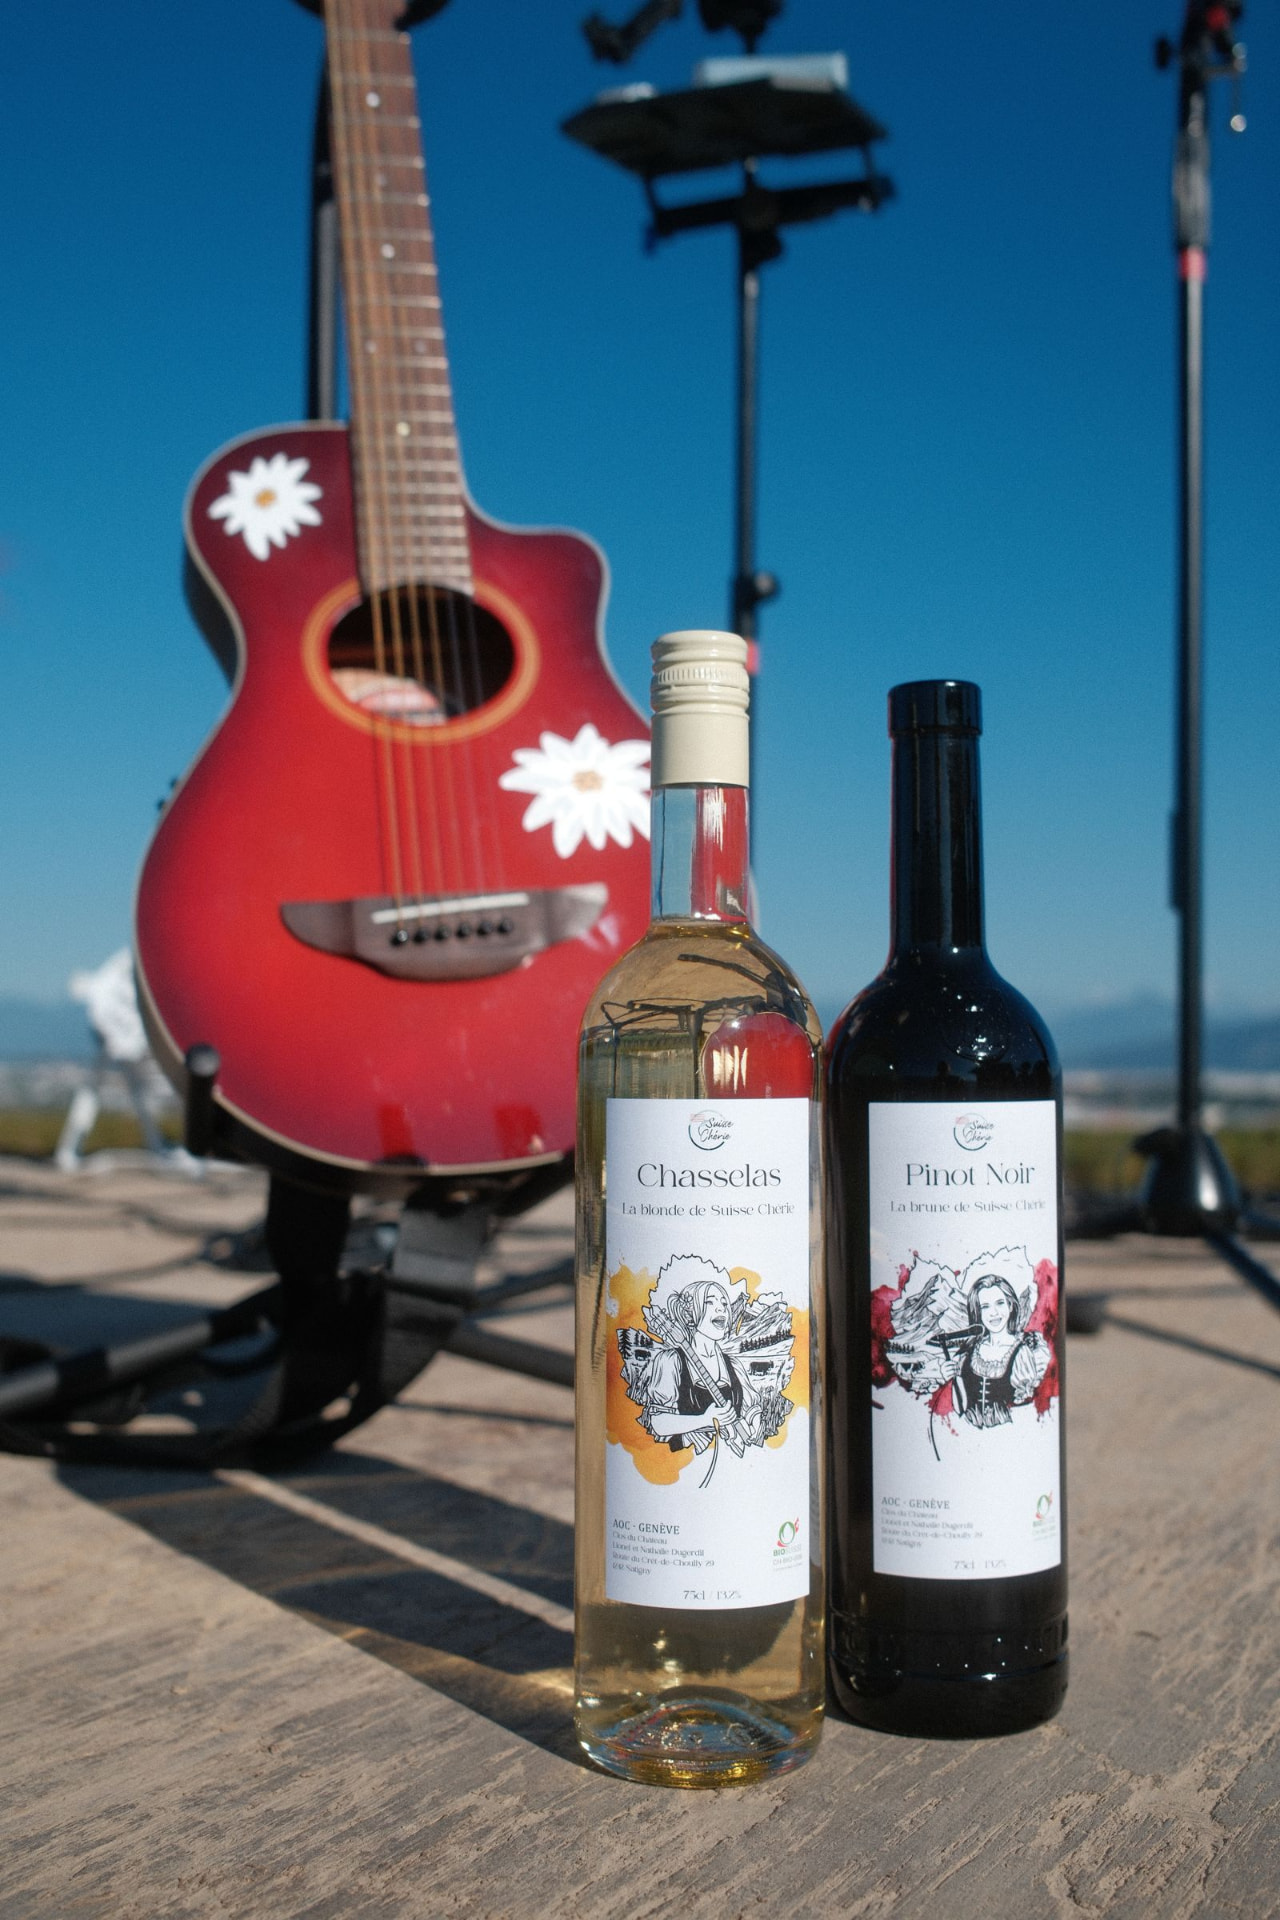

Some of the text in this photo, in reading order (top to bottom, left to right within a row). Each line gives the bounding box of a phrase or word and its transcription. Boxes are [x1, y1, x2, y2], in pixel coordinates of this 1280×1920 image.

[705, 1117, 734, 1129] Suisse
[637, 1162, 782, 1188] Chasselas
[906, 1162, 1035, 1186] Pinot Noir
[622, 1202, 637, 1216] La
[640, 1203, 685, 1217] blonde
[689, 1204, 706, 1217] de
[711, 1204, 754, 1216] Suisse
[890, 1200, 906, 1213] La
[910, 1200, 951, 1213] brune
[954, 1200, 970, 1213] de
[974, 1200, 1012, 1212] Suisse
[880, 1496, 901, 1507] AOC
[612, 1518, 631, 1531] AOC
